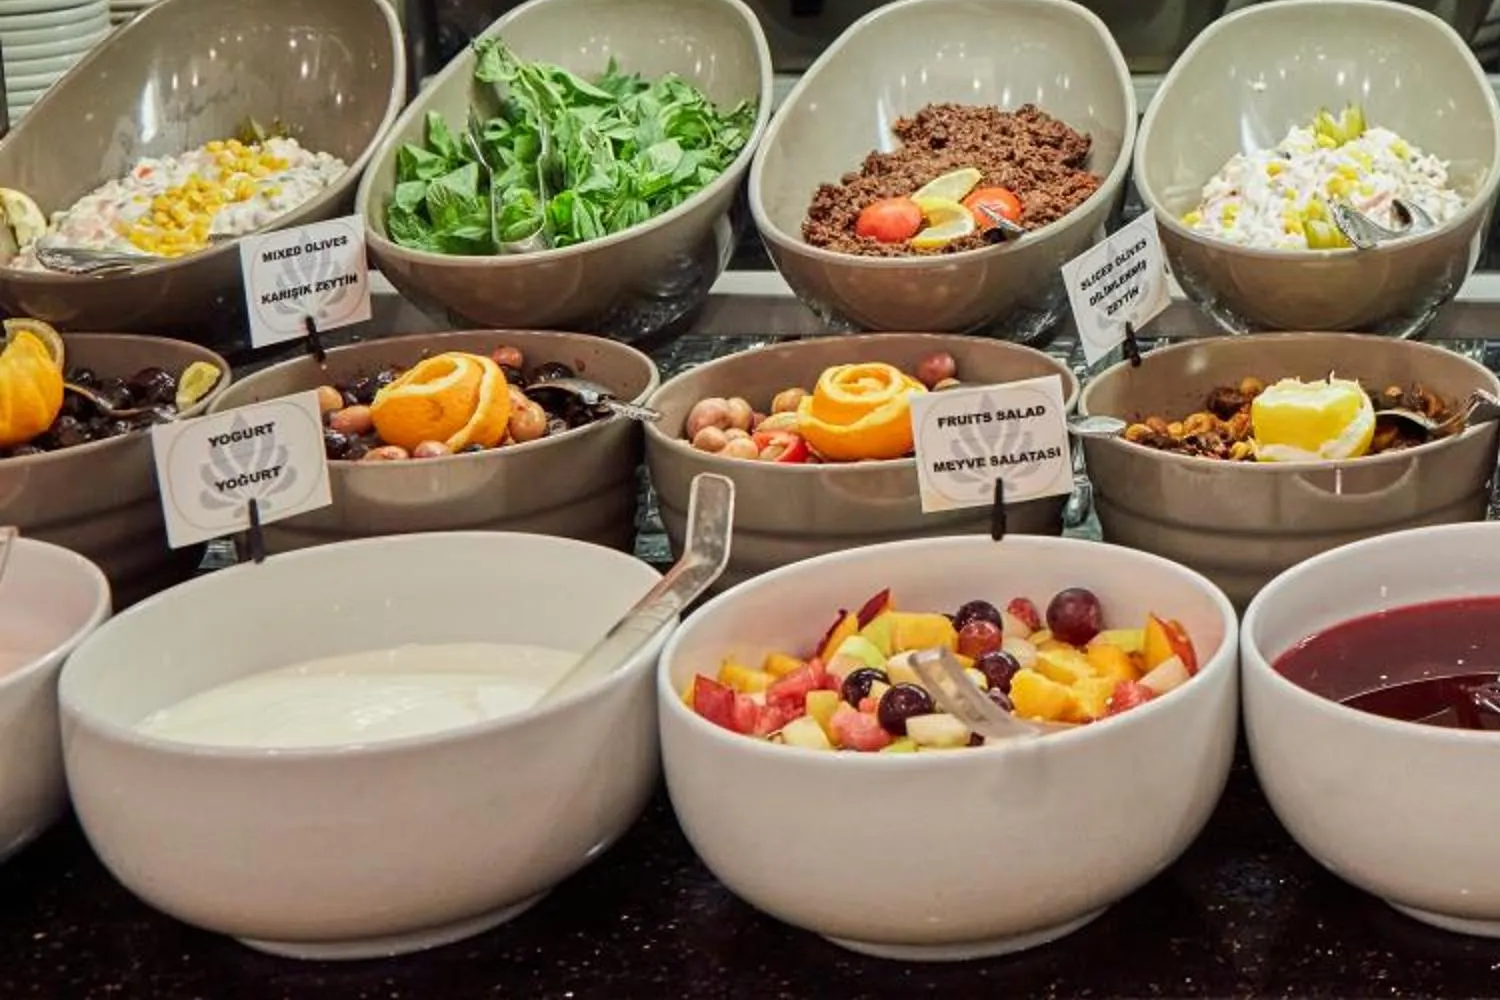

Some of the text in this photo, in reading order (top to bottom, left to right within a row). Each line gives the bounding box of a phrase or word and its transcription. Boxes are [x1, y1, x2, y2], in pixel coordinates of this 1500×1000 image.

[262, 235, 348, 263] MIXED OLIVES
[1080, 237, 1147, 291] SLICED OLIVES
[261, 273, 359, 306] KARIŞIK ZEYTİN
[1106, 285, 1139, 317] ZEYTİN
[937, 405, 1046, 428] FRUITS SALAD
[208, 422, 275, 448] YOGURT
[933, 447, 1062, 473] MEYVE SALATASI
[214, 465, 282, 492] YOĞURT
